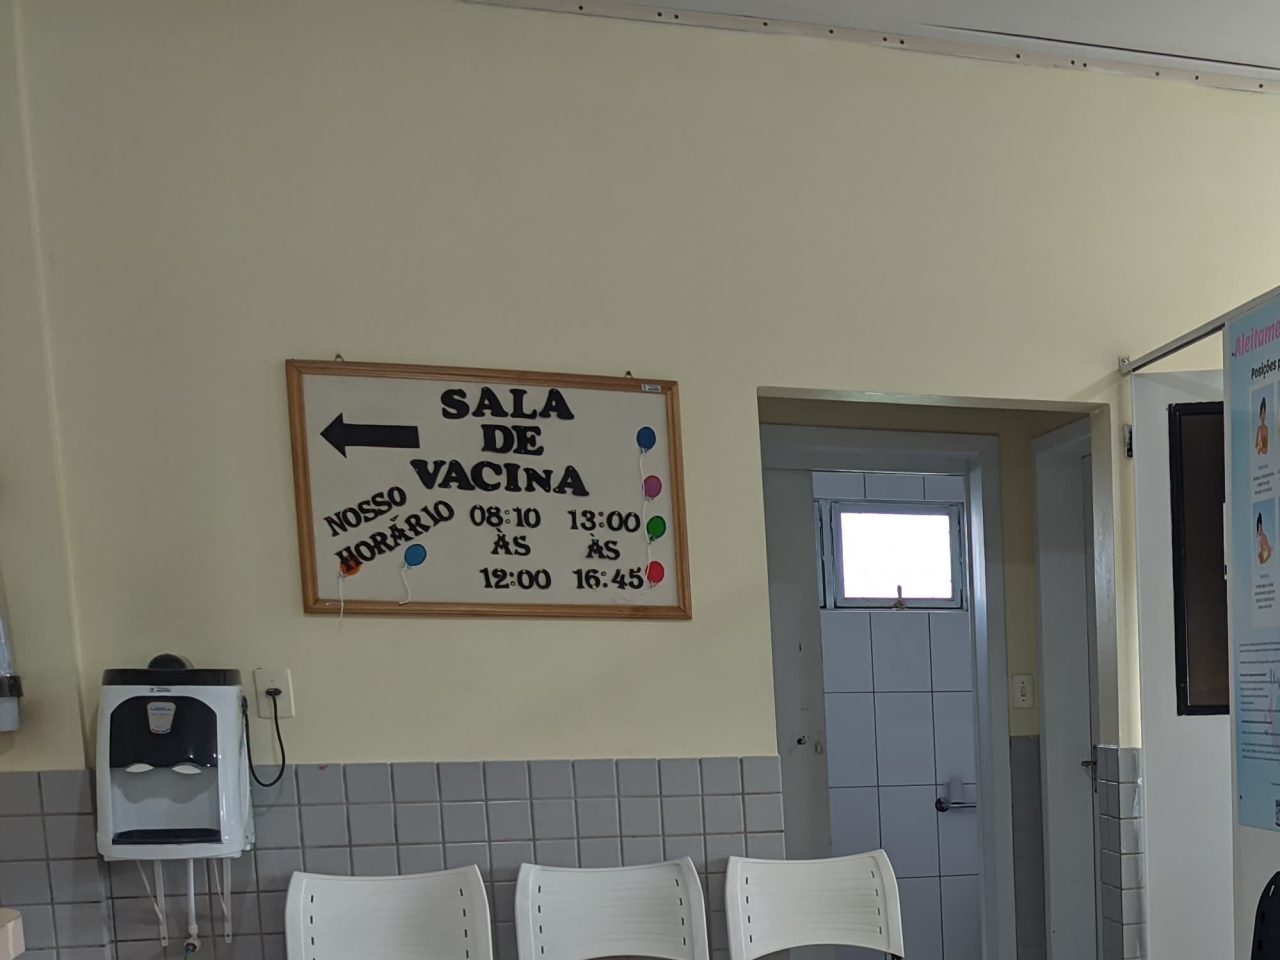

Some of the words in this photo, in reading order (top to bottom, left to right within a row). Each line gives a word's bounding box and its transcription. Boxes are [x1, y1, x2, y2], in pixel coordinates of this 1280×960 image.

[1250, 358, 1277, 380] Posições
[440, 386, 575, 420] SALA
[481, 423, 545, 456] DE
[409, 458, 590, 497] VACINA
[323, 486, 407, 538] NOSSO
[469, 504, 541, 528] 08:10
[567, 509, 641, 533] 13:00
[334, 500, 455, 568] HORÁRIO
[491, 527, 532, 556] ÀS
[585, 533, 621, 561] ÀS
[480, 567, 552, 590] 12:00
[572, 567, 644, 590] 16:45
